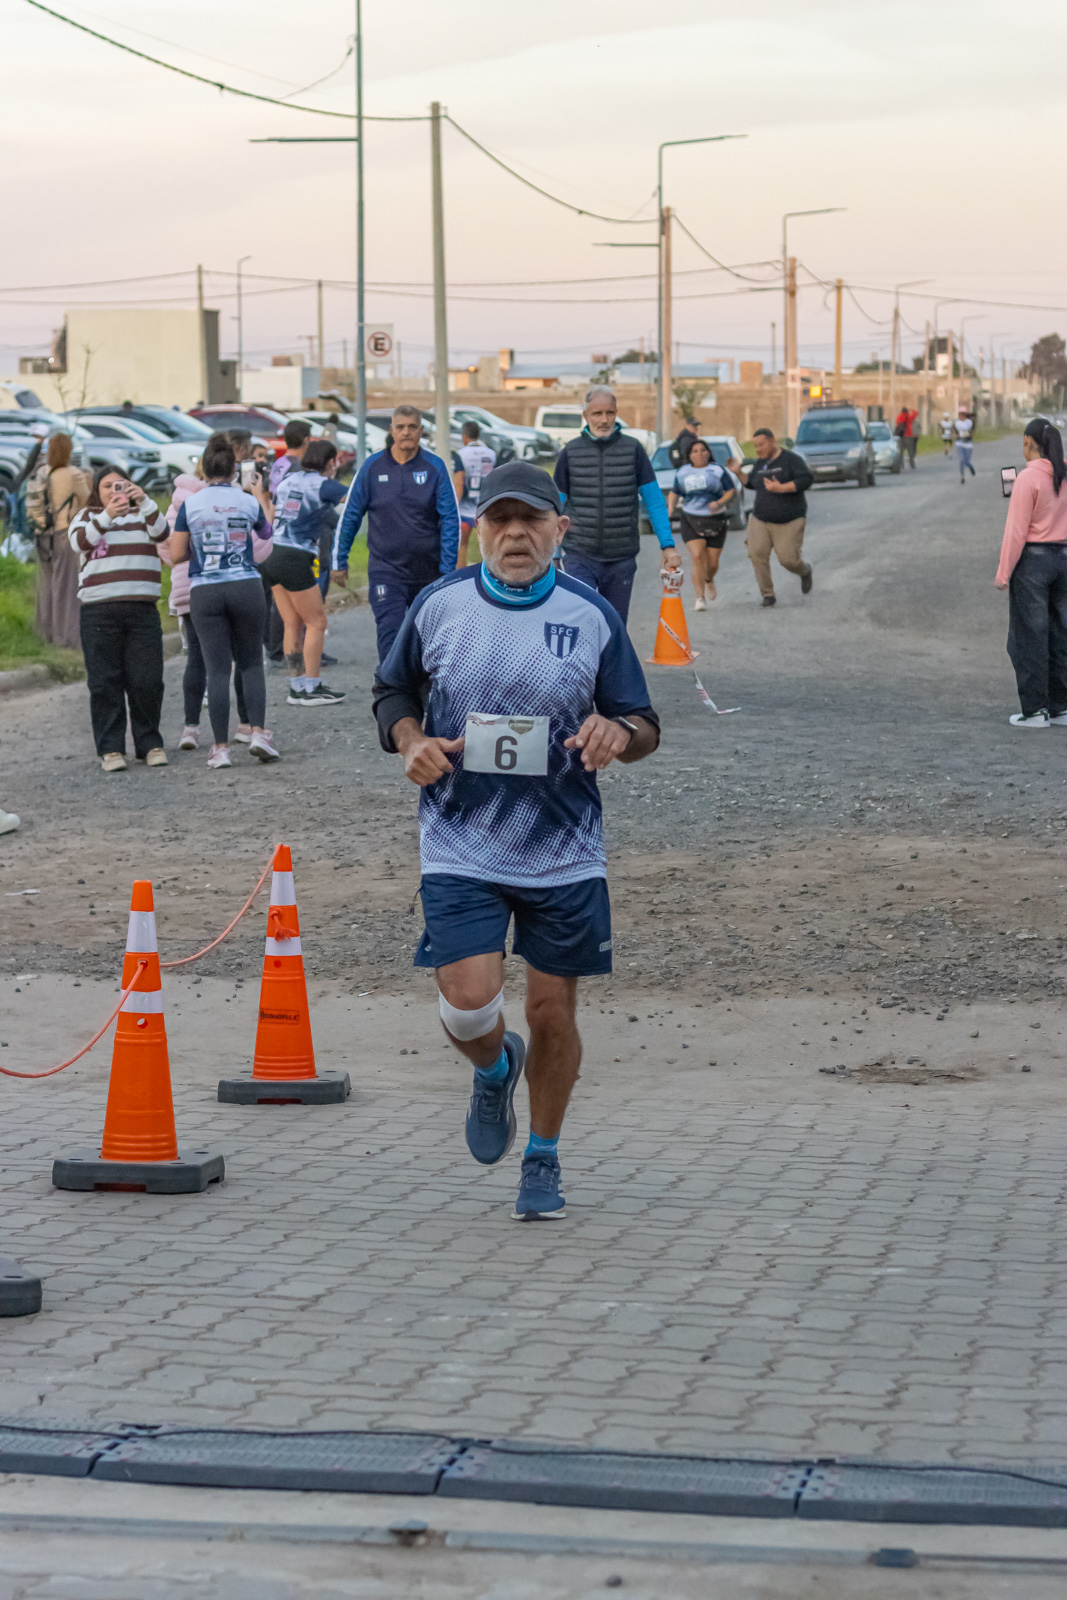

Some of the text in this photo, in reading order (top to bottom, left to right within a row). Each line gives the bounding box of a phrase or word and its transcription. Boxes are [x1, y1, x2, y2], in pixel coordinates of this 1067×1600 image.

[374, 337, 385, 351] E
[550, 625, 573, 637] SFC
[494, 735, 518, 770] 6
